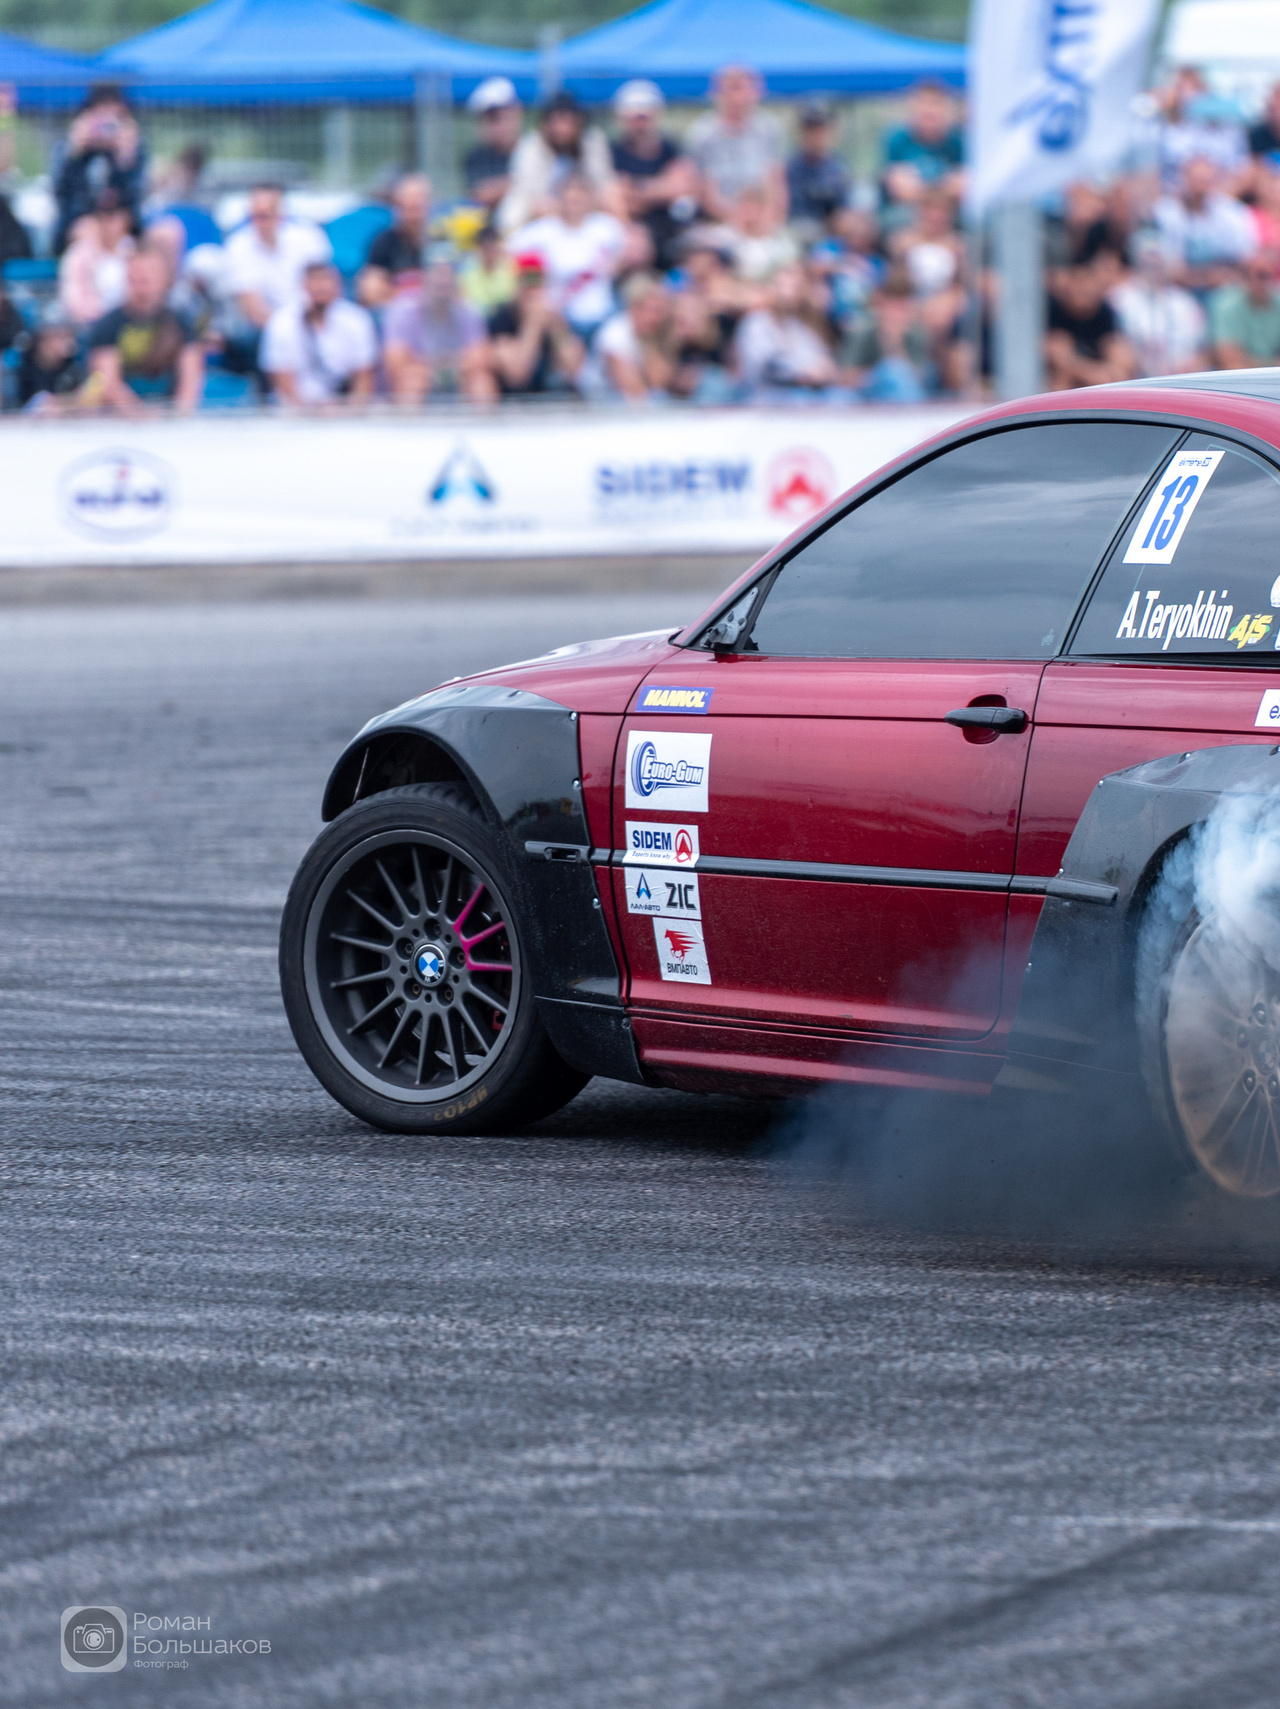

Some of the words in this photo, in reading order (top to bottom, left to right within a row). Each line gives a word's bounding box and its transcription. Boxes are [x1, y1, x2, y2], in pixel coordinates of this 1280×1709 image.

[1141, 474, 1200, 550] 13
[1115, 590, 1234, 651] A.Teryokhin
[643, 689, 706, 708] MANNOL
[632, 829, 672, 850] SIDEM
[664, 882, 697, 910] ZIC
[667, 962, 699, 976] ВМПАВТО
